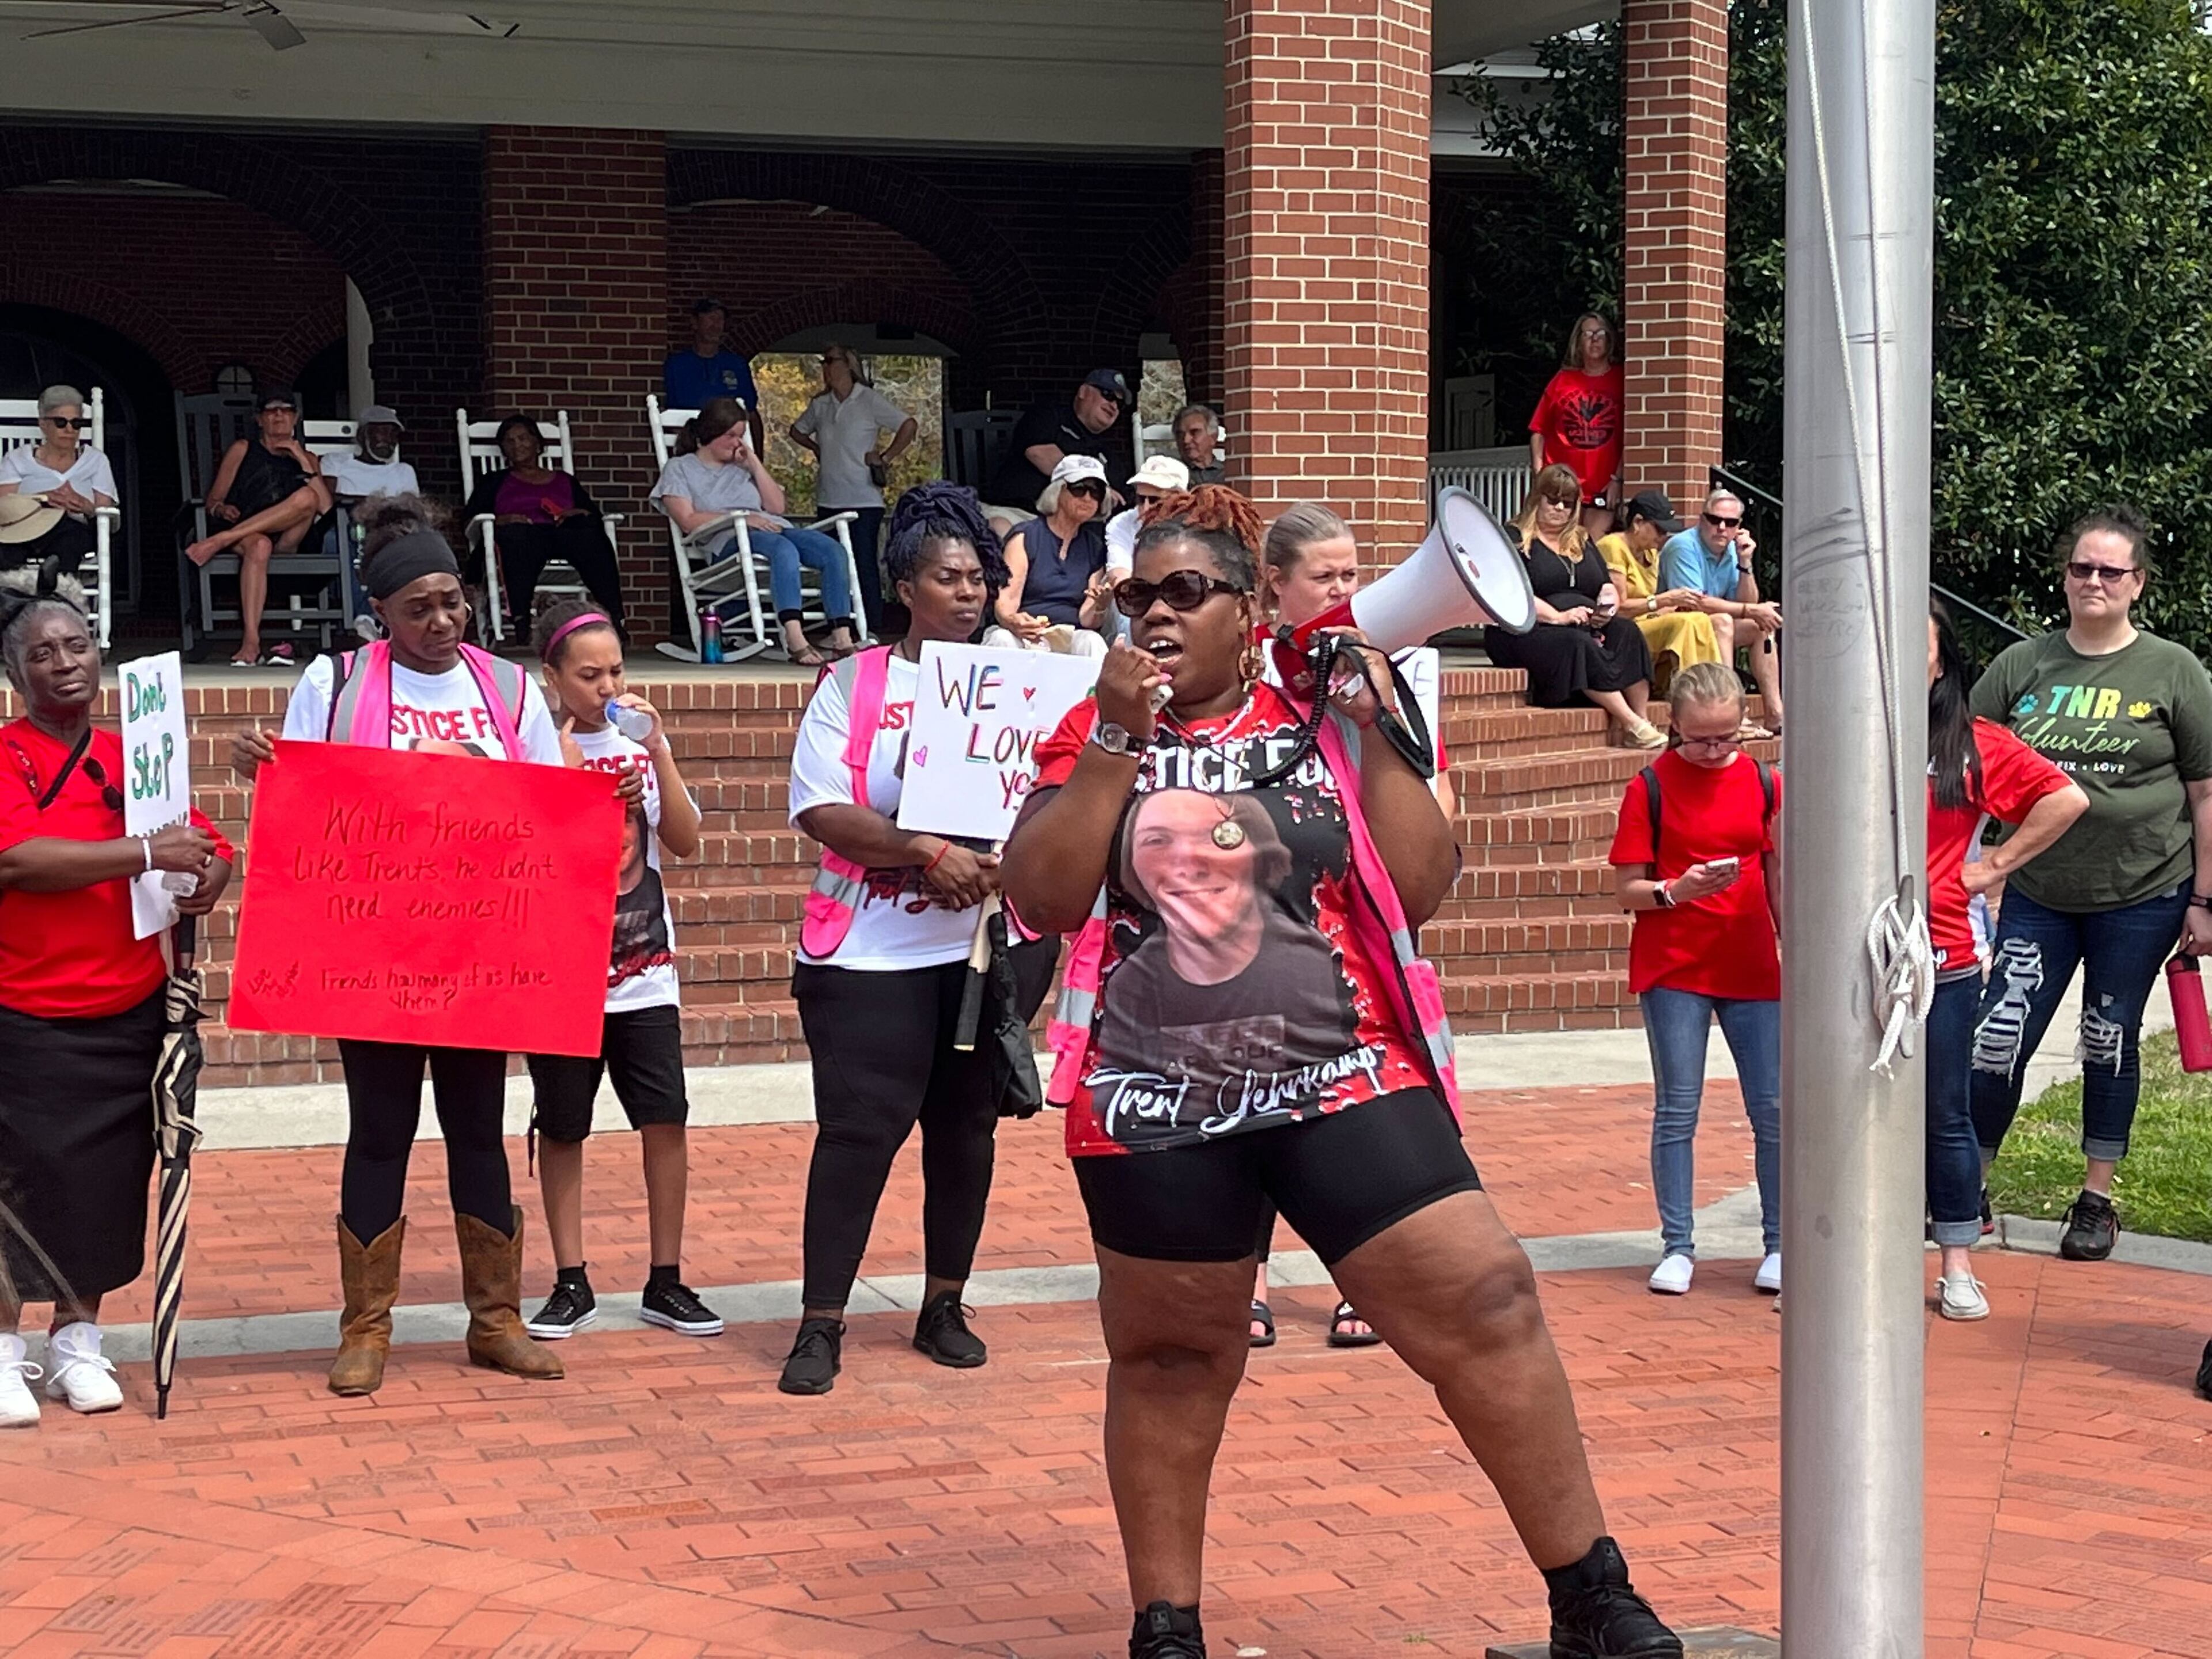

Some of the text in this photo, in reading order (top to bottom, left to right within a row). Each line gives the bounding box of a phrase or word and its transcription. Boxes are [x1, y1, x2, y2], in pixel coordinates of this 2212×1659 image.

[936, 656, 1004, 717] WE
[2046, 684, 2122, 719] TNR
[392, 704, 471, 740] STICE
[1134, 738, 1336, 793] TICE FO
[2093, 761, 2126, 774] LOVE
[324, 797, 533, 848] With friends
[455, 855, 482, 880] he
[1085, 1067, 1202, 1137] Trent
